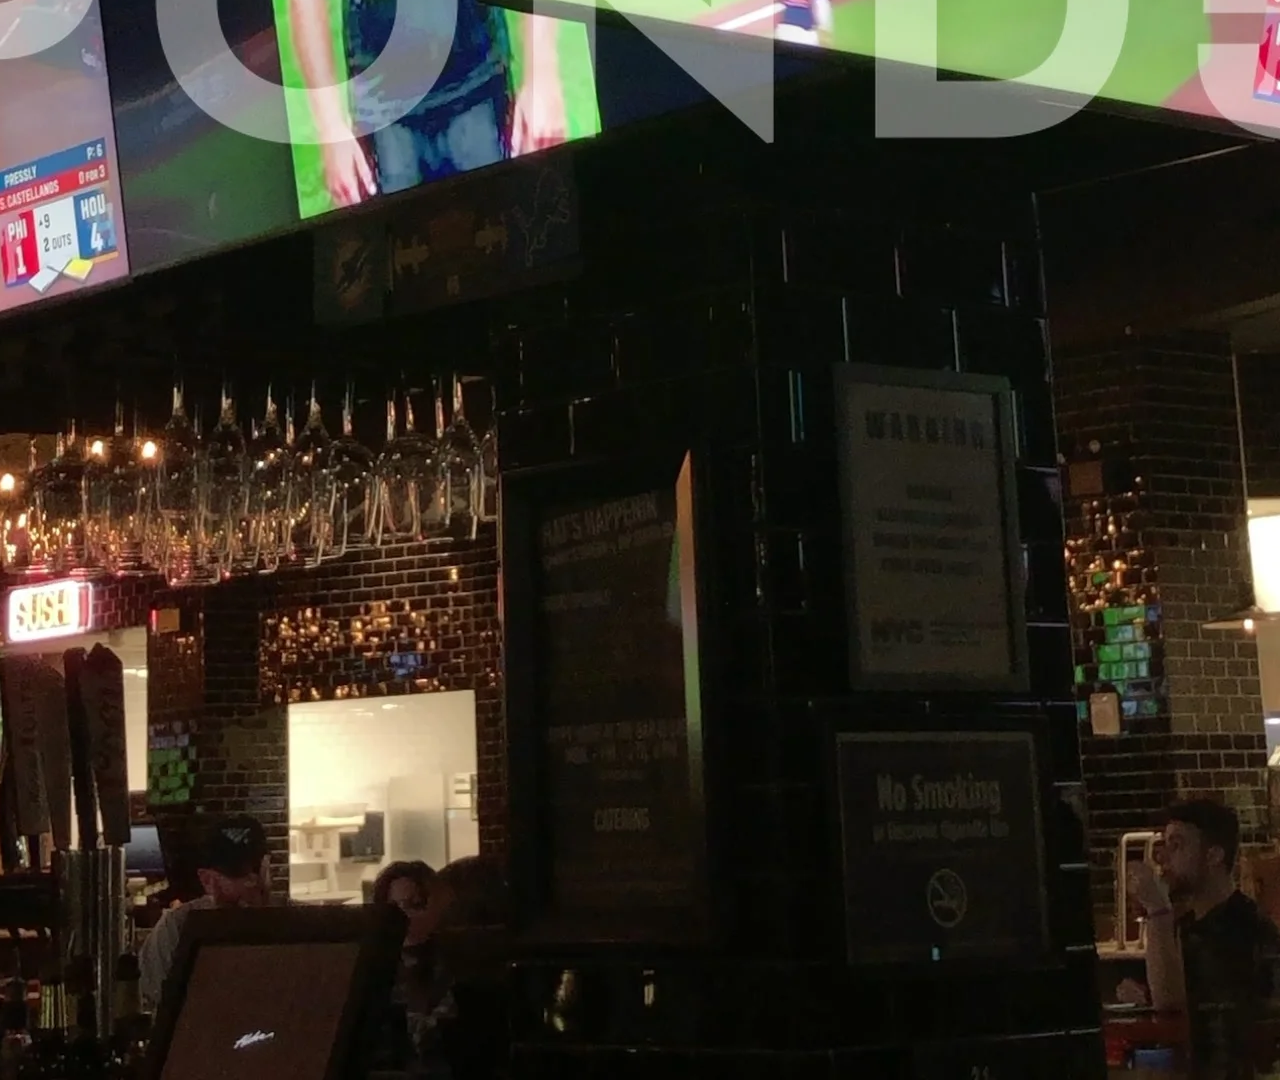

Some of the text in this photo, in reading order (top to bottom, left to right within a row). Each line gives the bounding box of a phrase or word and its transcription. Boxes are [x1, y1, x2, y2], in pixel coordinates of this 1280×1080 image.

[4, 165, 38, 188] PRESSLY
[96, 144, 103, 157] 6
[6, 180, 60, 208] CASTELLANOS
[85, 170, 99, 182] FOR
[98, 165, 105, 178] 3
[80, 193, 106, 220] HOU
[7, 218, 27, 242] PHI
[43, 233, 72, 252] 2 OUTS
[90, 223, 104, 252] 4
[15, 245, 27, 276] 1
[877, 771, 1002, 814] No Smoking
